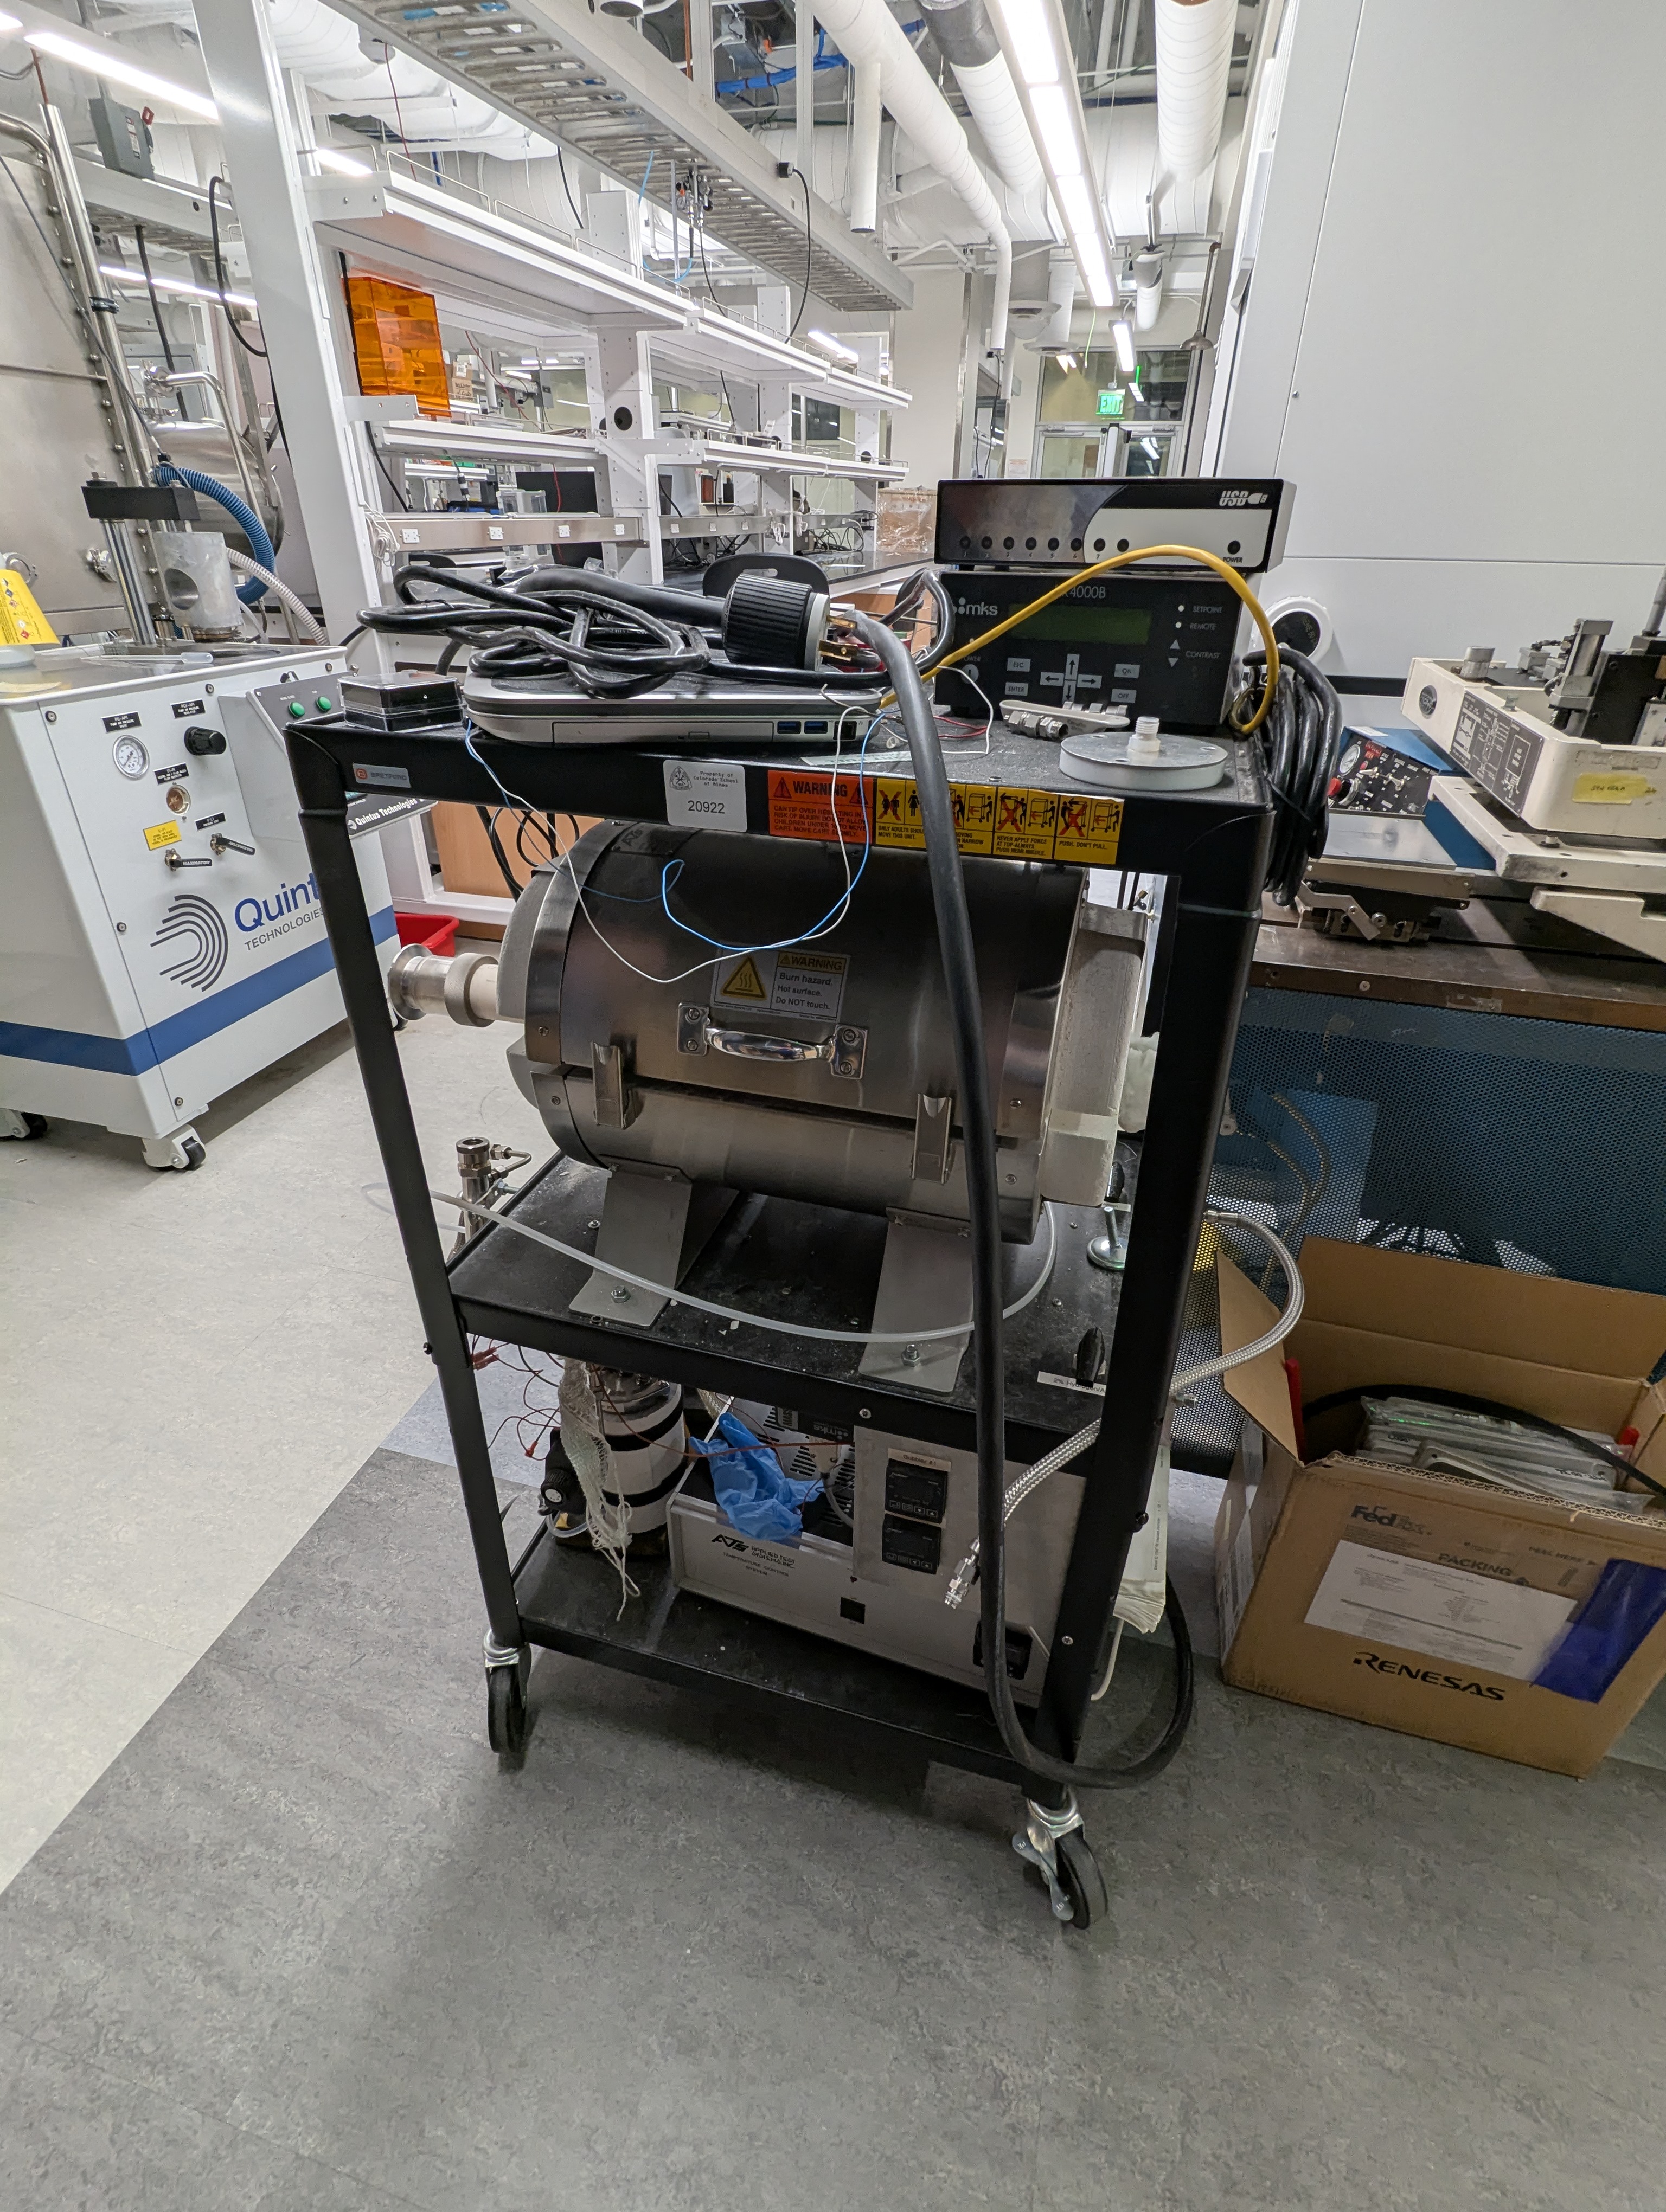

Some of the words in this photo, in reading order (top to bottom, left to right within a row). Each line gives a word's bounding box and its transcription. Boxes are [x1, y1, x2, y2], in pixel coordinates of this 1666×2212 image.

[1100, 395, 1123, 413] EXIT
[1219, 491, 1248, 506] USB
[1065, 586, 1106, 599] 4000B
[966, 602, 998, 616] mks
[1193, 606, 1223, 614] SETPOINT
[1185, 651, 1221, 659] CONTRAST
[370, 772, 407, 780] BRETFORD
[355, 812, 381, 826] Quintus
[379, 798, 418, 816] Technologies
[688, 800, 725, 814] 20922
[234, 872, 320, 933] Quint
[791, 956, 843, 971] WARNING
[779, 972, 800, 982] Burn
[802, 975, 833, 986] hazard.
[777, 985, 791, 993] Hot
[792, 988, 822, 996] surface.
[788, 998, 806, 1007] NOT
[807, 1001, 830, 1010] touch.
[813, 1424, 837, 1436] mks
[751, 1546, 779, 1558] APPLIED
[780, 1555, 796, 1564] TEST
[722, 1552, 761, 1567] TEMPERATURE
[764, 1565, 789, 1577] CONTROL
[745, 1565, 768, 1576] SYSTEM
[1438, 1552, 1513, 1577] PACKING
[1353, 1651, 1505, 1701] RENESAS
